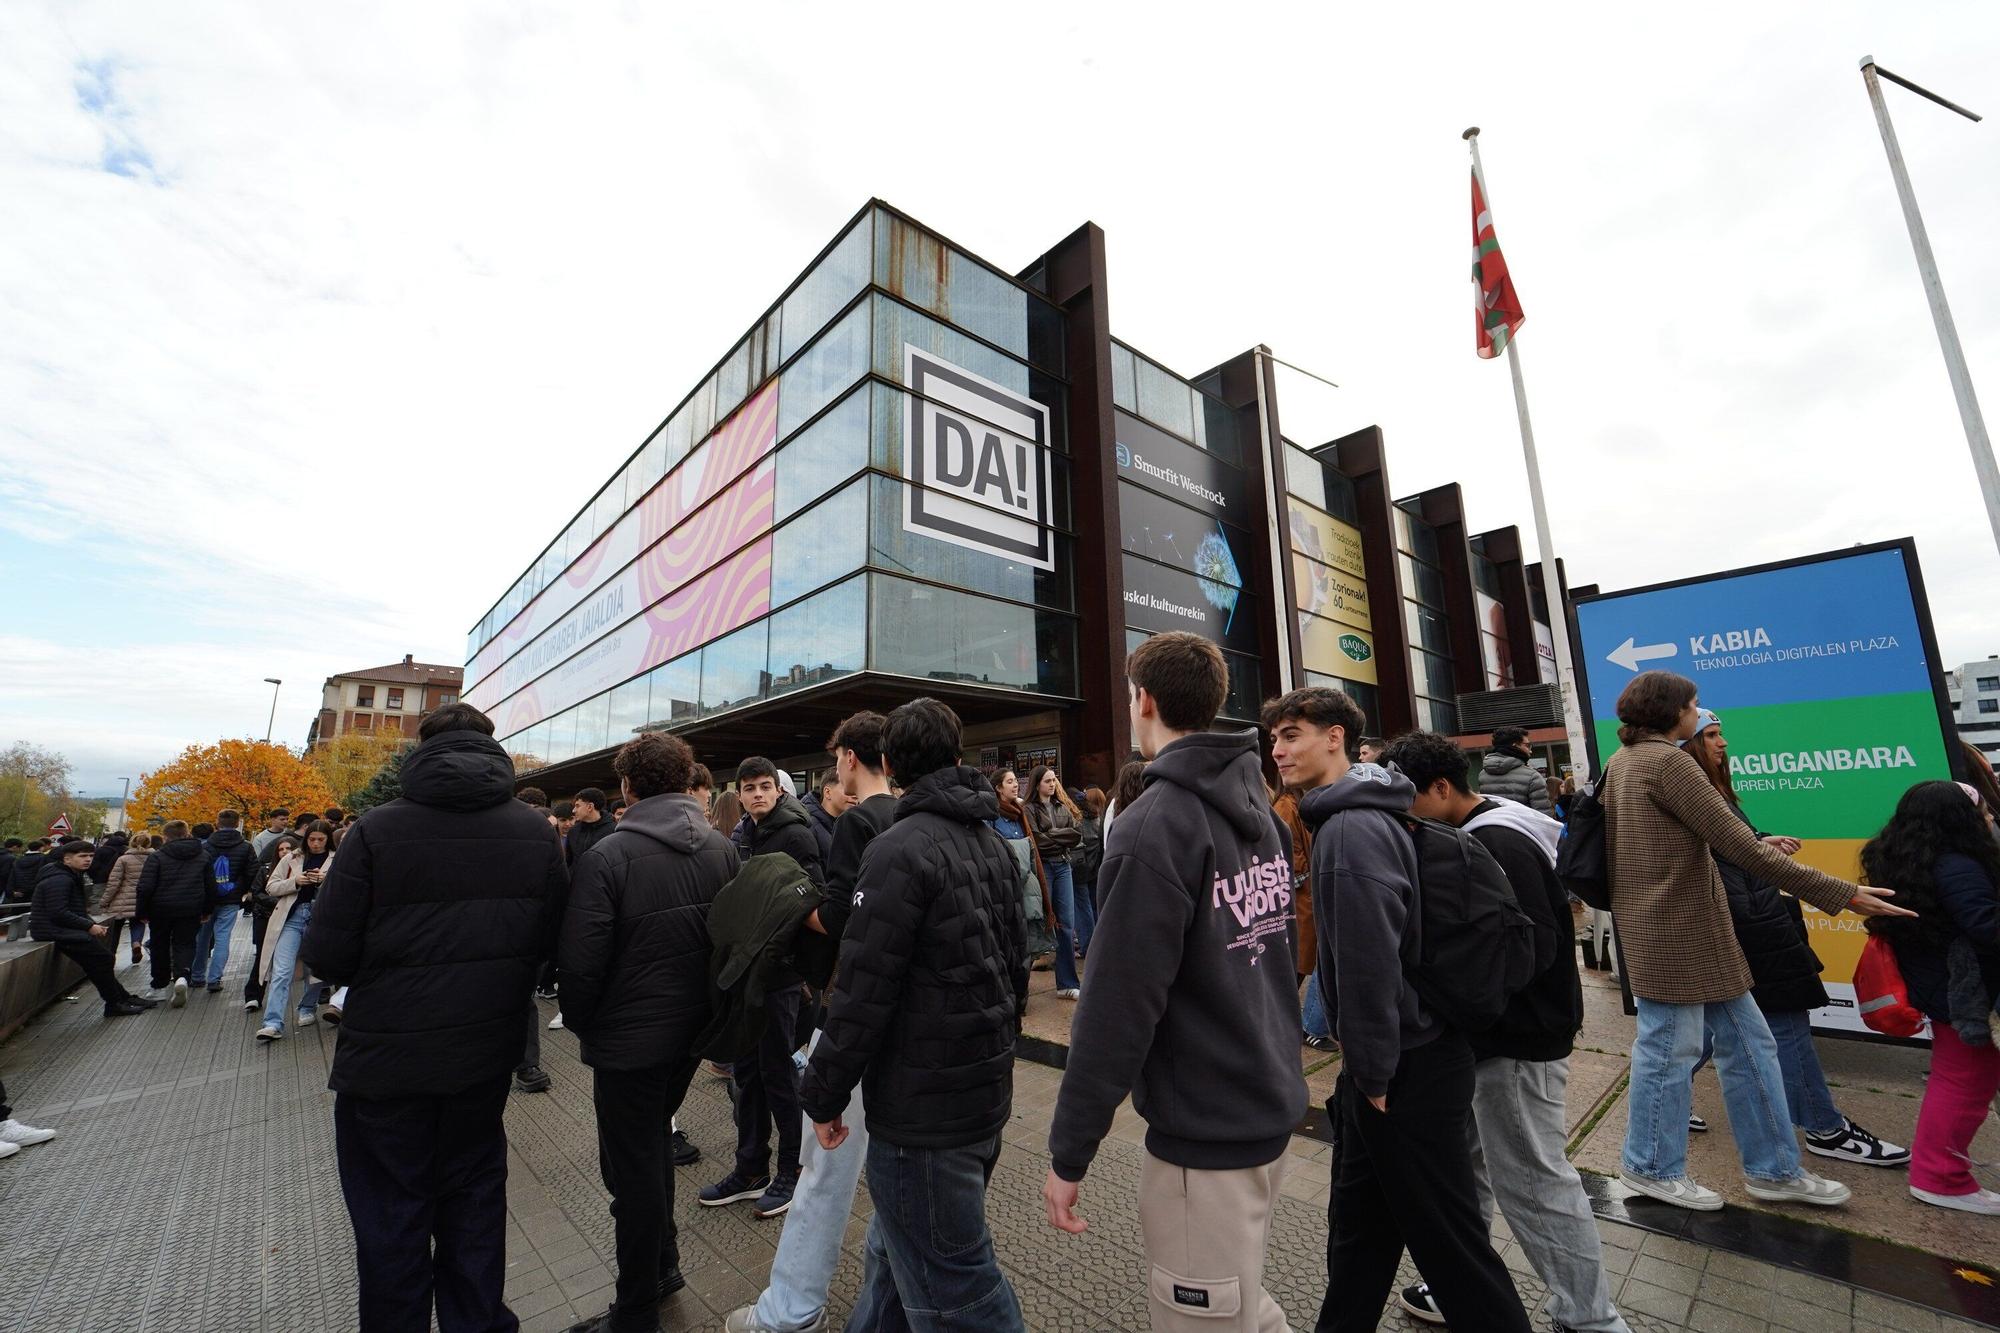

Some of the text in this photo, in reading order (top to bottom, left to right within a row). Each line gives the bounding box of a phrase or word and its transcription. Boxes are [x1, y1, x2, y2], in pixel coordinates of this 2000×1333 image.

[935, 412, 1029, 511] DA!
[1134, 454, 1226, 508] Smurfit Westrock
[1123, 590, 1206, 622] uskal kulturarekin
[1331, 578, 1366, 603] Zorionak!
[579, 584, 624, 640] JAIALDIA
[1689, 627, 1772, 656] KABIA
[1694, 636, 1900, 672] TEKNOLOGIA DIGITALEN PLAZA
[1729, 745, 1917, 776] AGUGANBARA
[1731, 776, 1824, 793] URREN PLAZA
[1819, 918, 1867, 933] PLAZA
